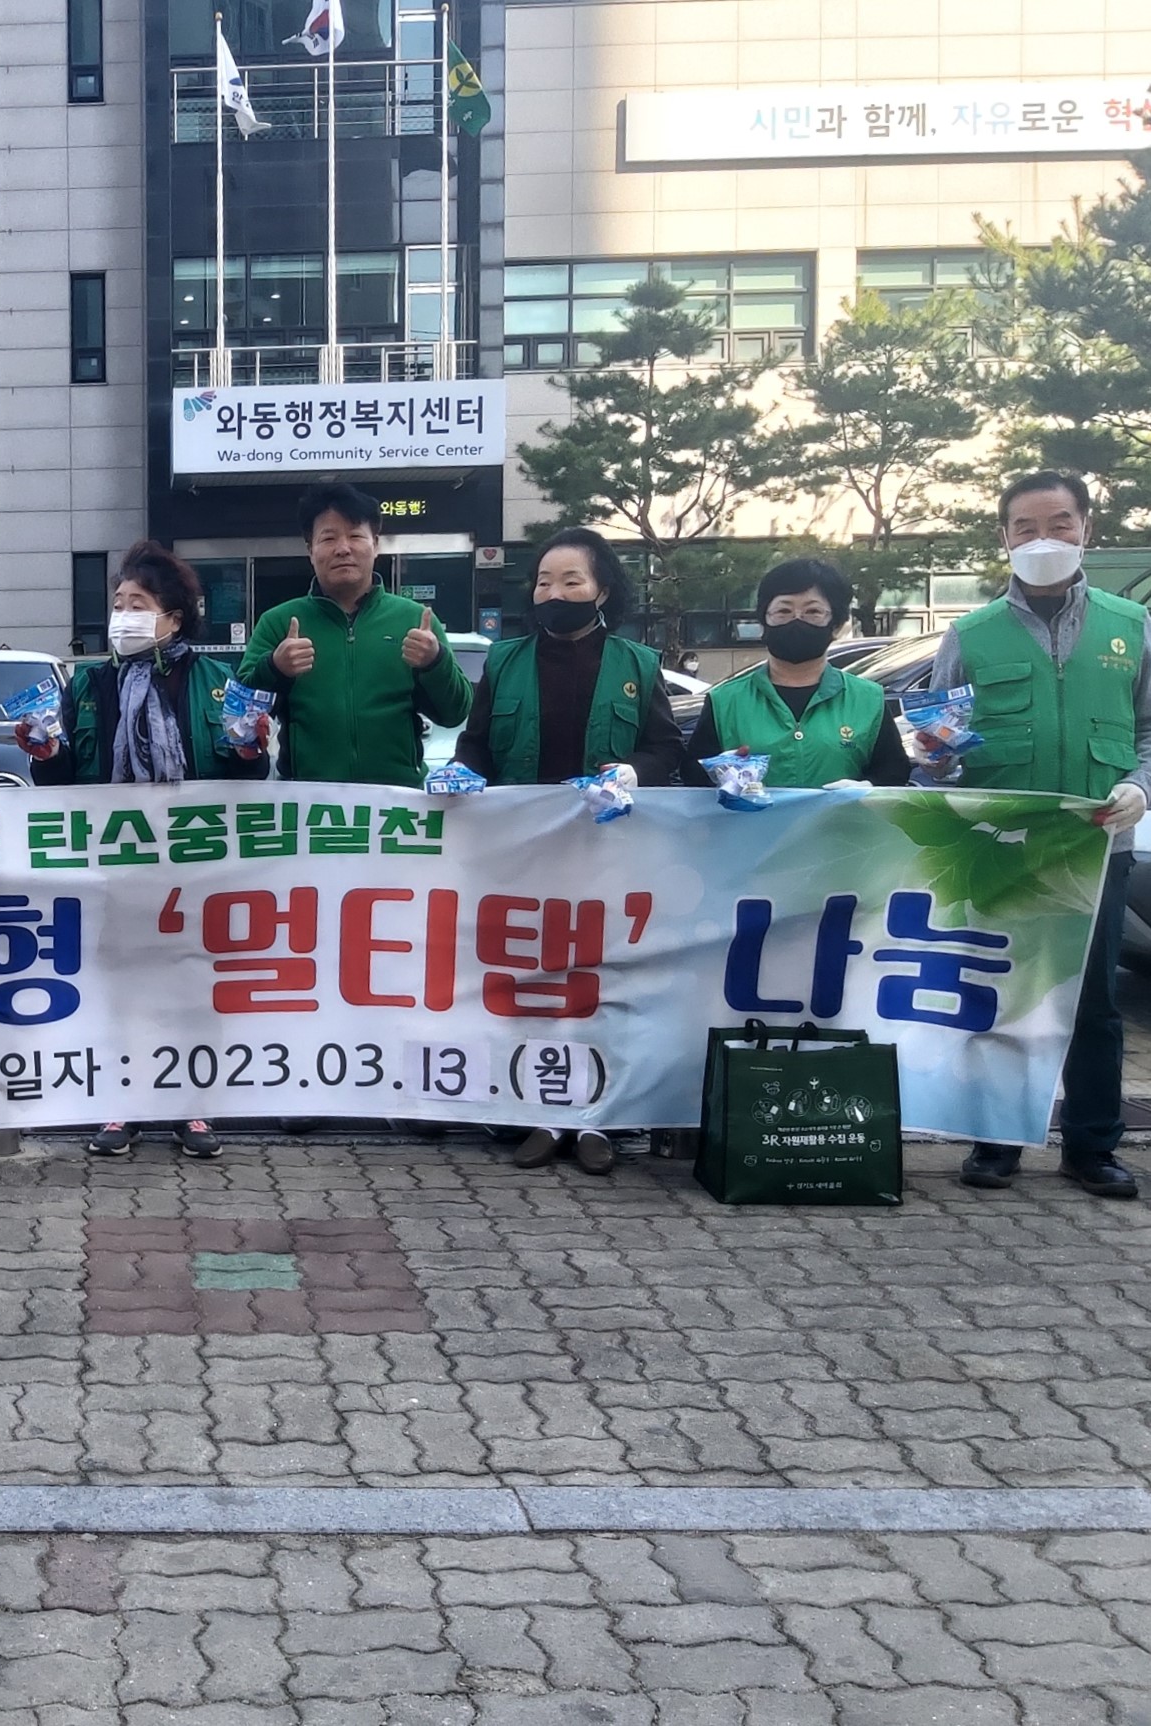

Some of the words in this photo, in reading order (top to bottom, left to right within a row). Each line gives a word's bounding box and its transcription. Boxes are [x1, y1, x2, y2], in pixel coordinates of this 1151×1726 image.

[749, 105, 847, 140] 시민과
[863, 103, 937, 138] 함께,
[951, 99, 1084, 135] 자유로운
[216, 395, 484, 440] 와동행정복지센터
[217, 449, 283, 463] Wa-dong
[289, 446, 373, 462] Community
[379, 445, 429, 458] Service
[435, 443, 484, 457] Center
[28, 802, 445, 868] 탄소중립실천
[724, 891, 1012, 1032] 나눔
[762, 1134, 781, 1146] 3R
[782, 1134, 826, 1146] 자원재활용
[828, 1133, 846, 1144] 수집
[848, 1133, 865, 1144] 운동
